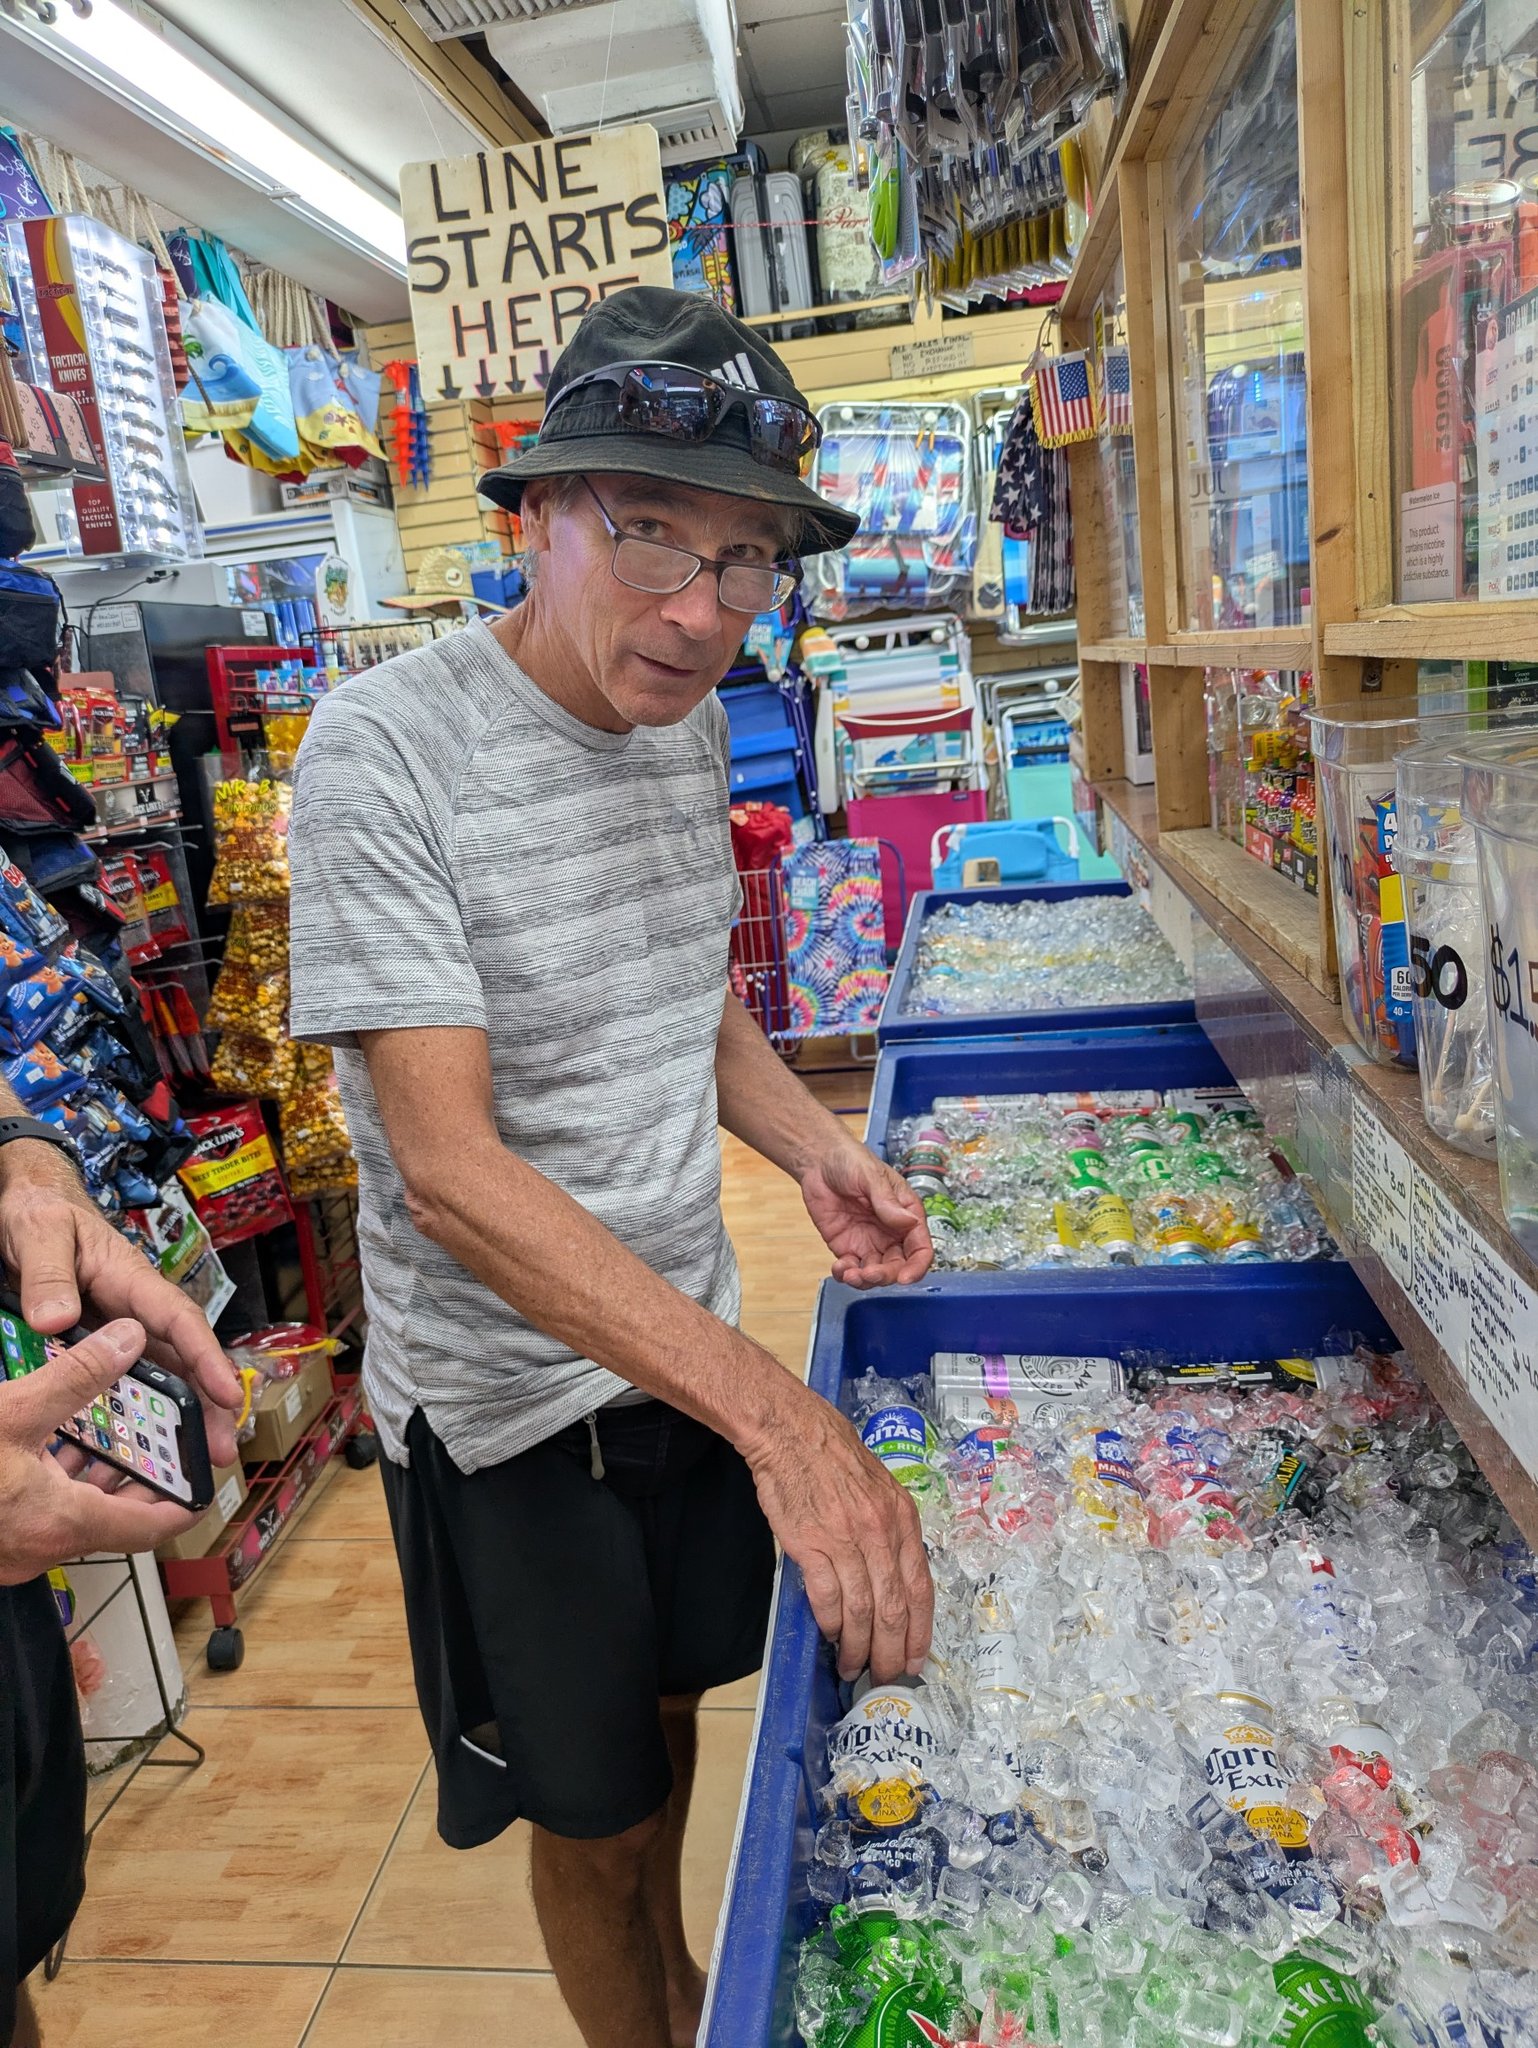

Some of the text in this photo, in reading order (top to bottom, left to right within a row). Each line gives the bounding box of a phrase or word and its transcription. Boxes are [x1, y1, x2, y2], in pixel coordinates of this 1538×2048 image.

[431, 136, 598, 222] LINE
[409, 193, 668, 293] STARTS
[452, 276, 639, 357] HER
[51, 353, 88, 369] TACTICAL
[1048, 357, 1066, 367] USA
[58, 368, 87, 383] KNIVES
[1409, 494, 1433, 506] Watermelon
[82, 506, 110, 514] QUALITY
[81, 514, 114, 522] TACTICAL
[85, 521, 113, 529] KNIVES
[1409, 524, 1439, 538] This product
[1405, 538, 1445, 553] contains nicotine
[1407, 556, 1418, 567] which
[1418, 556, 1424, 566] is
[1428, 553, 1444, 567] highly
[1403, 568, 1450, 581] addictive substance.
[215, 780, 246, 802] MR
[793, 887, 816, 897] CHAIR
[1393, 1006, 1403, 1016] 40
[192, 1171, 211, 1184] BEEF
[212, 1160, 241, 1176] TENDER
[1075, 1357, 1097, 1391] CLAW
[864, 1425, 923, 1447] RITAS
[856, 1746, 922, 1769] Extra
[1226, 1768, 1289, 1793] Extr
[1267, 1809, 1282, 1817] LA
